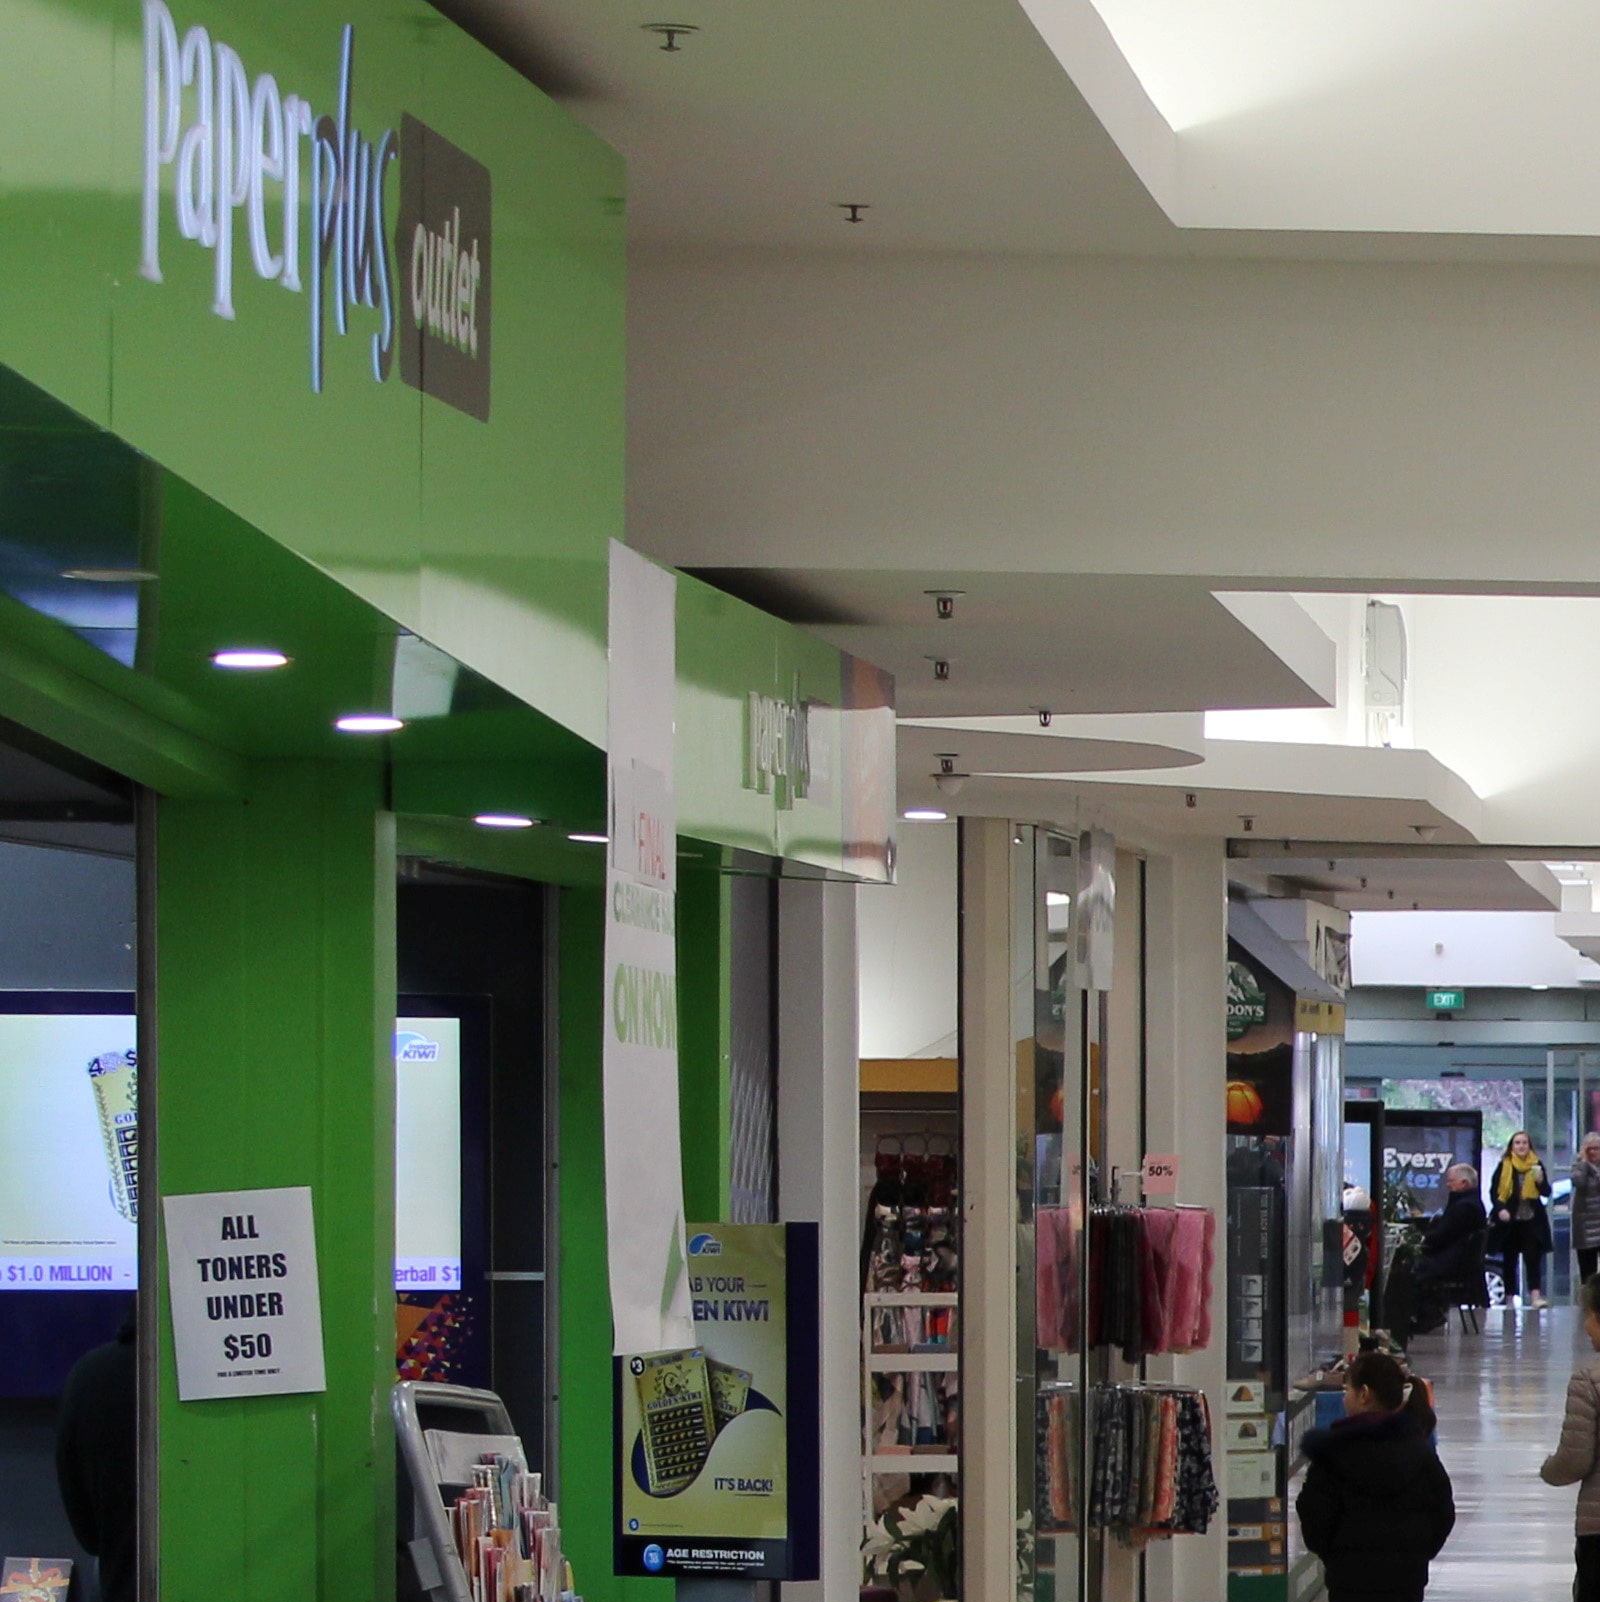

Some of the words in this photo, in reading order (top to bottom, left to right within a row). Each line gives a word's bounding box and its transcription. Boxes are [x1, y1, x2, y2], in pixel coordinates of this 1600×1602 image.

[411, 206, 481, 360] outlet
[1434, 993, 1455, 1006] EXIT
[403, 1050, 437, 1060] KIWI
[1383, 1147, 1454, 1173] Every
[1148, 1165, 1174, 1177] 50%
[221, 1215, 259, 1240] ALL
[7, 1264, 44, 1284] $1.0
[50, 1264, 113, 1283] MILLION
[197, 1253, 287, 1282] TONERS
[704, 1276, 745, 1293] YOUR
[206, 1292, 284, 1321] UNDER
[723, 1300, 769, 1322] KIWI
[224, 1333, 272, 1361] $50
[714, 1477, 735, 1491] IT'S
[738, 1478, 773, 1492] BACK!
[666, 1548, 689, 1558] AGE
[691, 1549, 765, 1560] RESTRICTION
